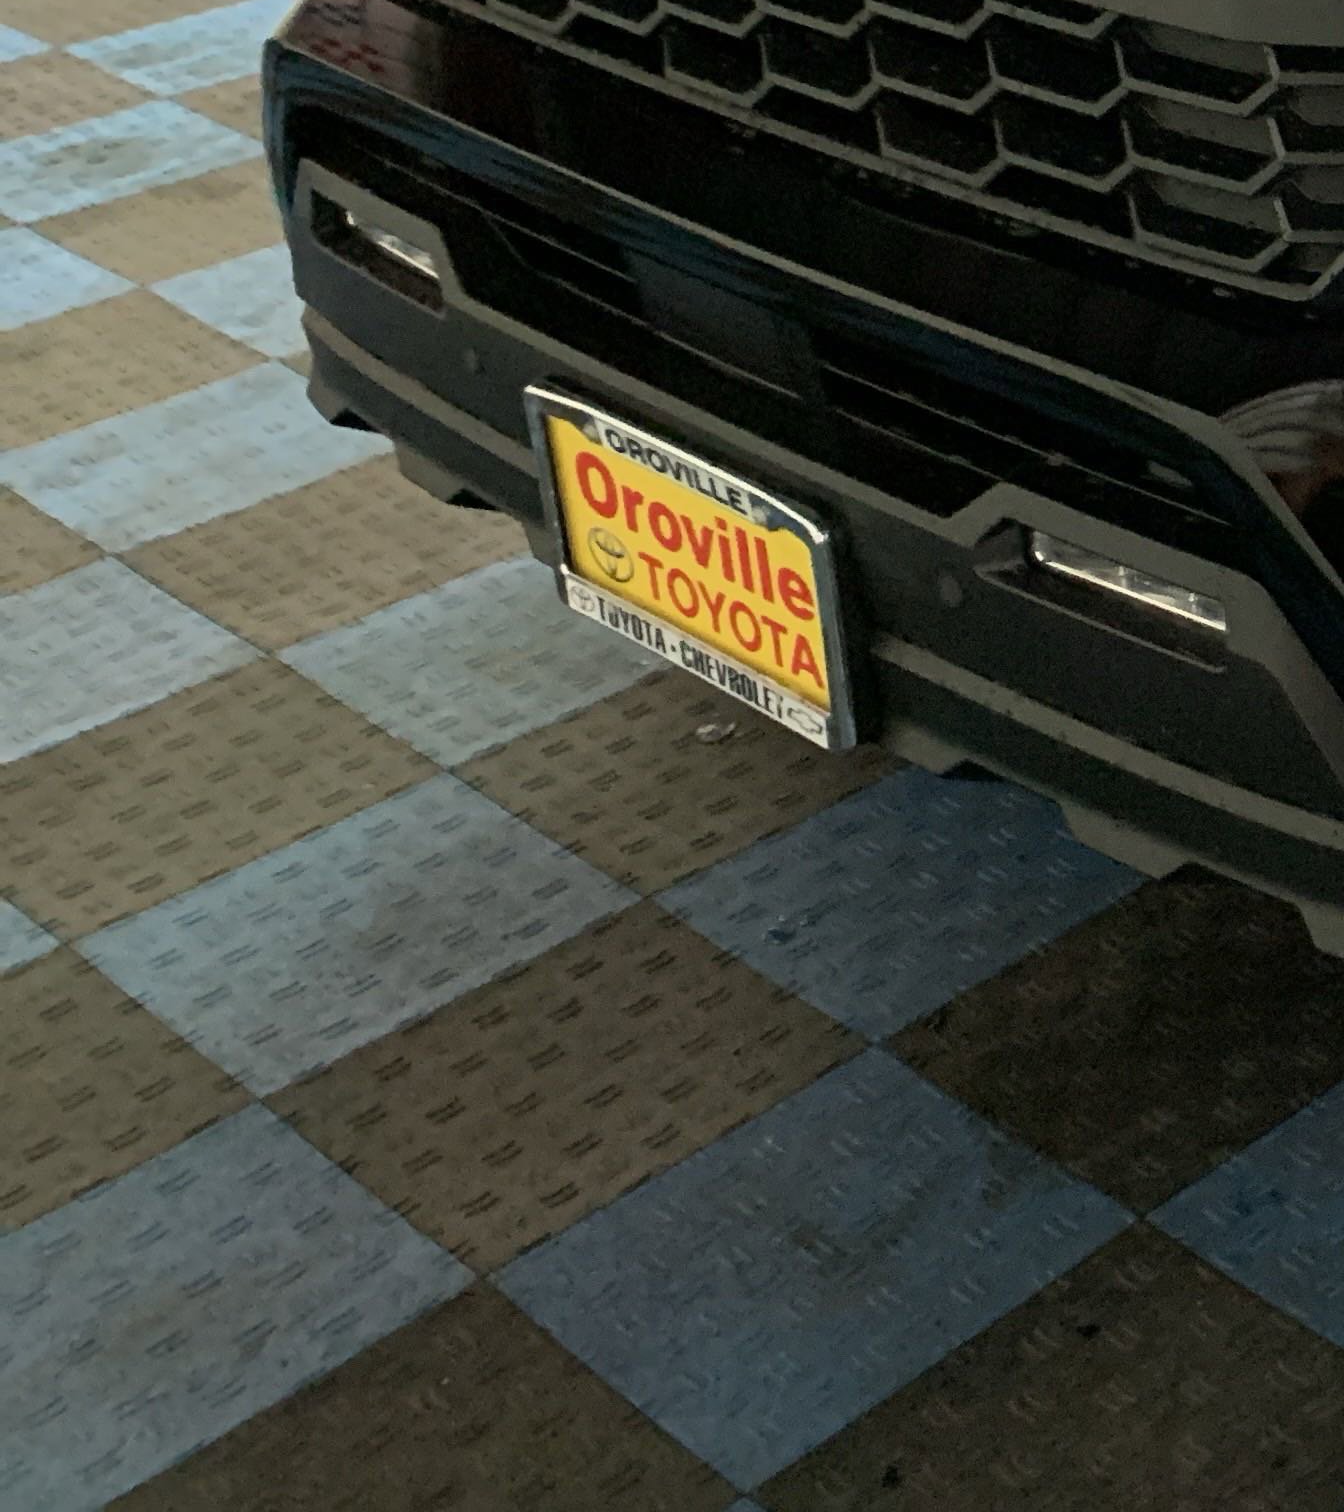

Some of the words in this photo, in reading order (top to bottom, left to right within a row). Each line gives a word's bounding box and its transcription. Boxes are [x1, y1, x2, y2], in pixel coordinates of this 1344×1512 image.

[575, 451, 815, 621] Oroville
[604, 428, 746, 514] OROVILLE
[598, 596, 667, 655] TOYOTA
[679, 638, 786, 720] CHEVROLET
[638, 551, 826, 690] TOYOTA
